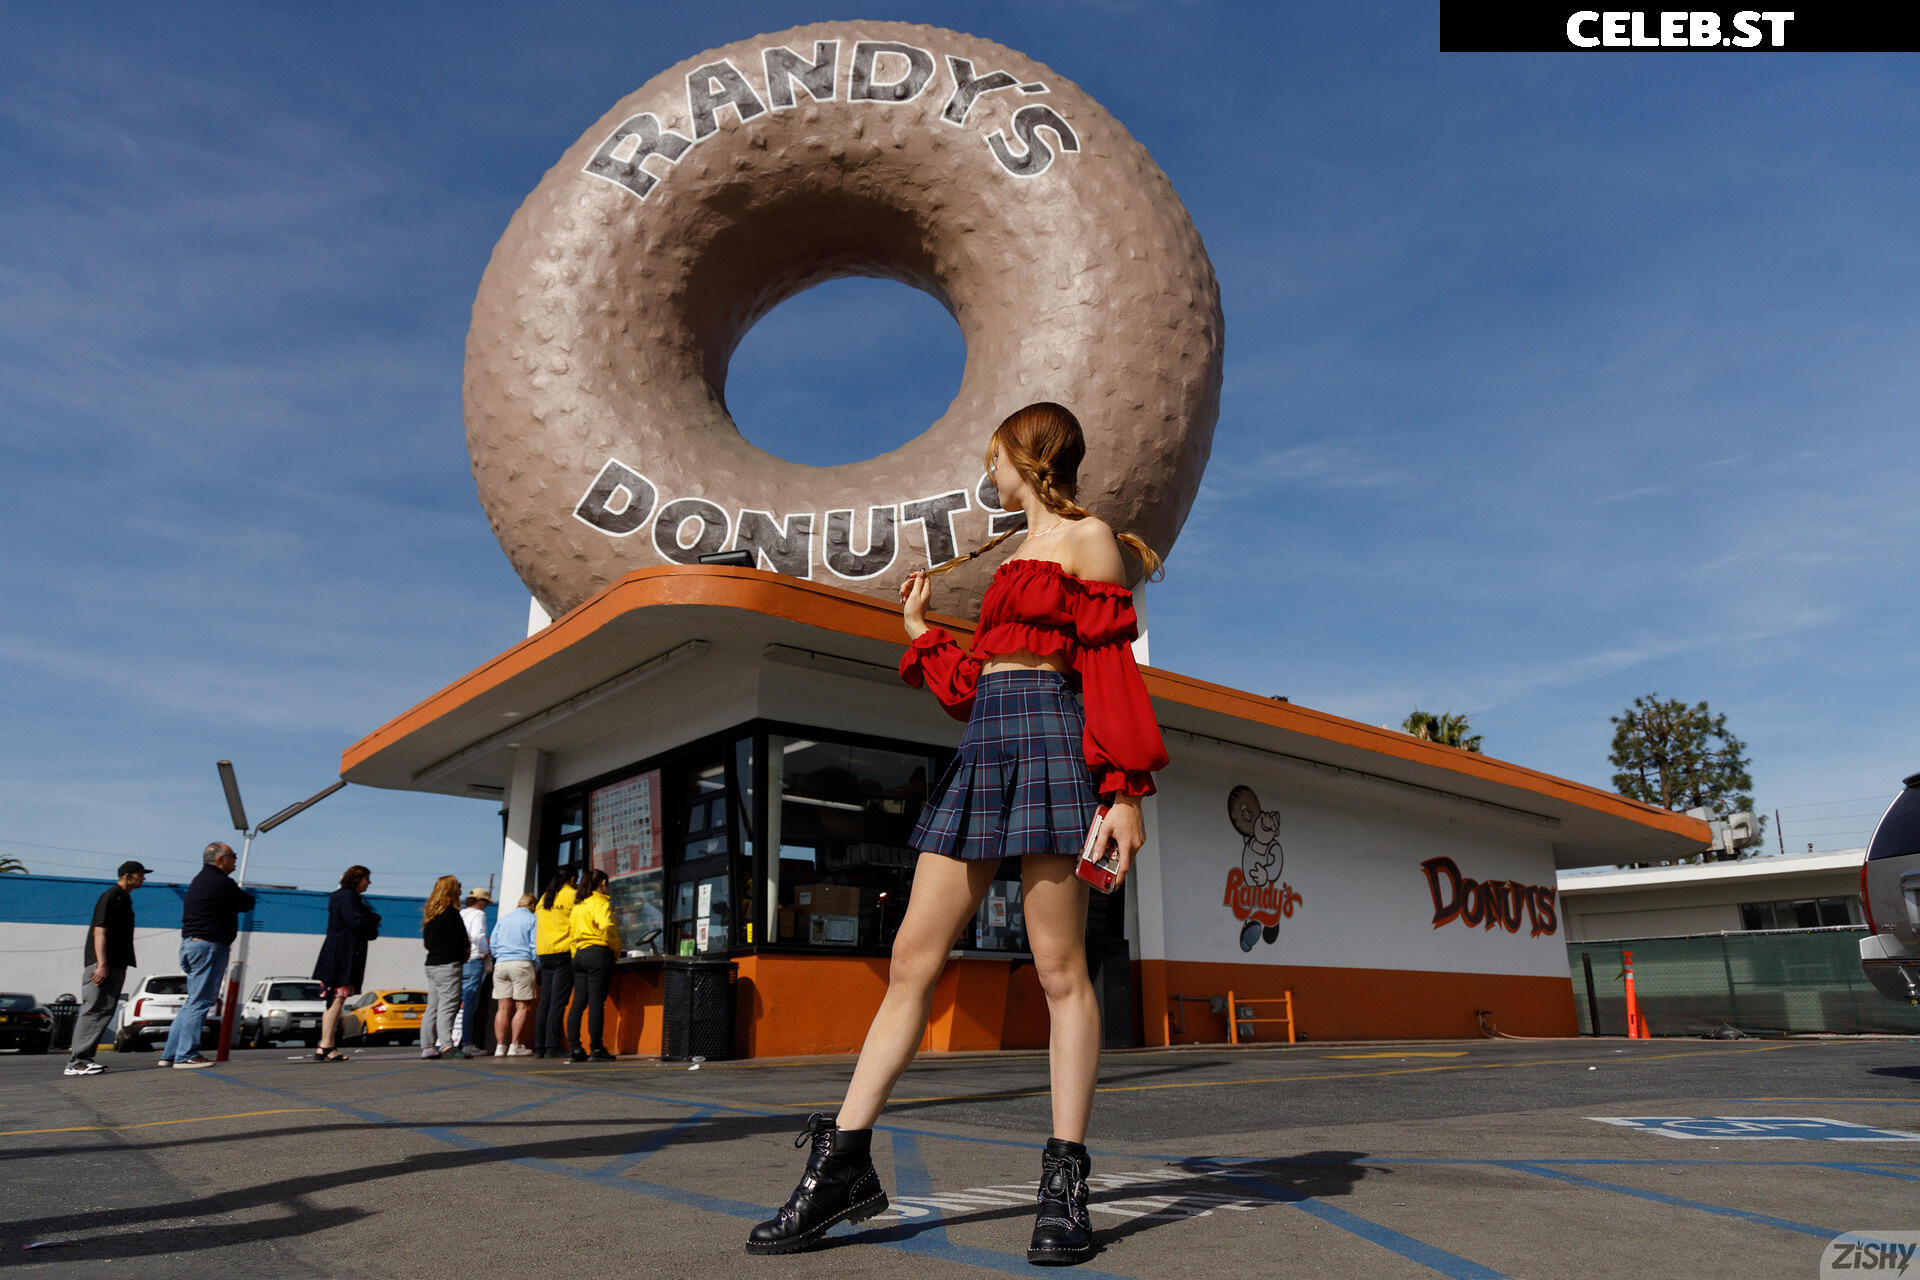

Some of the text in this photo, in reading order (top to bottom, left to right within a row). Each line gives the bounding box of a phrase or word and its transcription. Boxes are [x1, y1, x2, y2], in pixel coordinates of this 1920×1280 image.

[582, 38, 1081, 201] RANDY'S
[1223, 867, 1303, 927] Randy's
[1420, 855, 1558, 938] DONUTS
